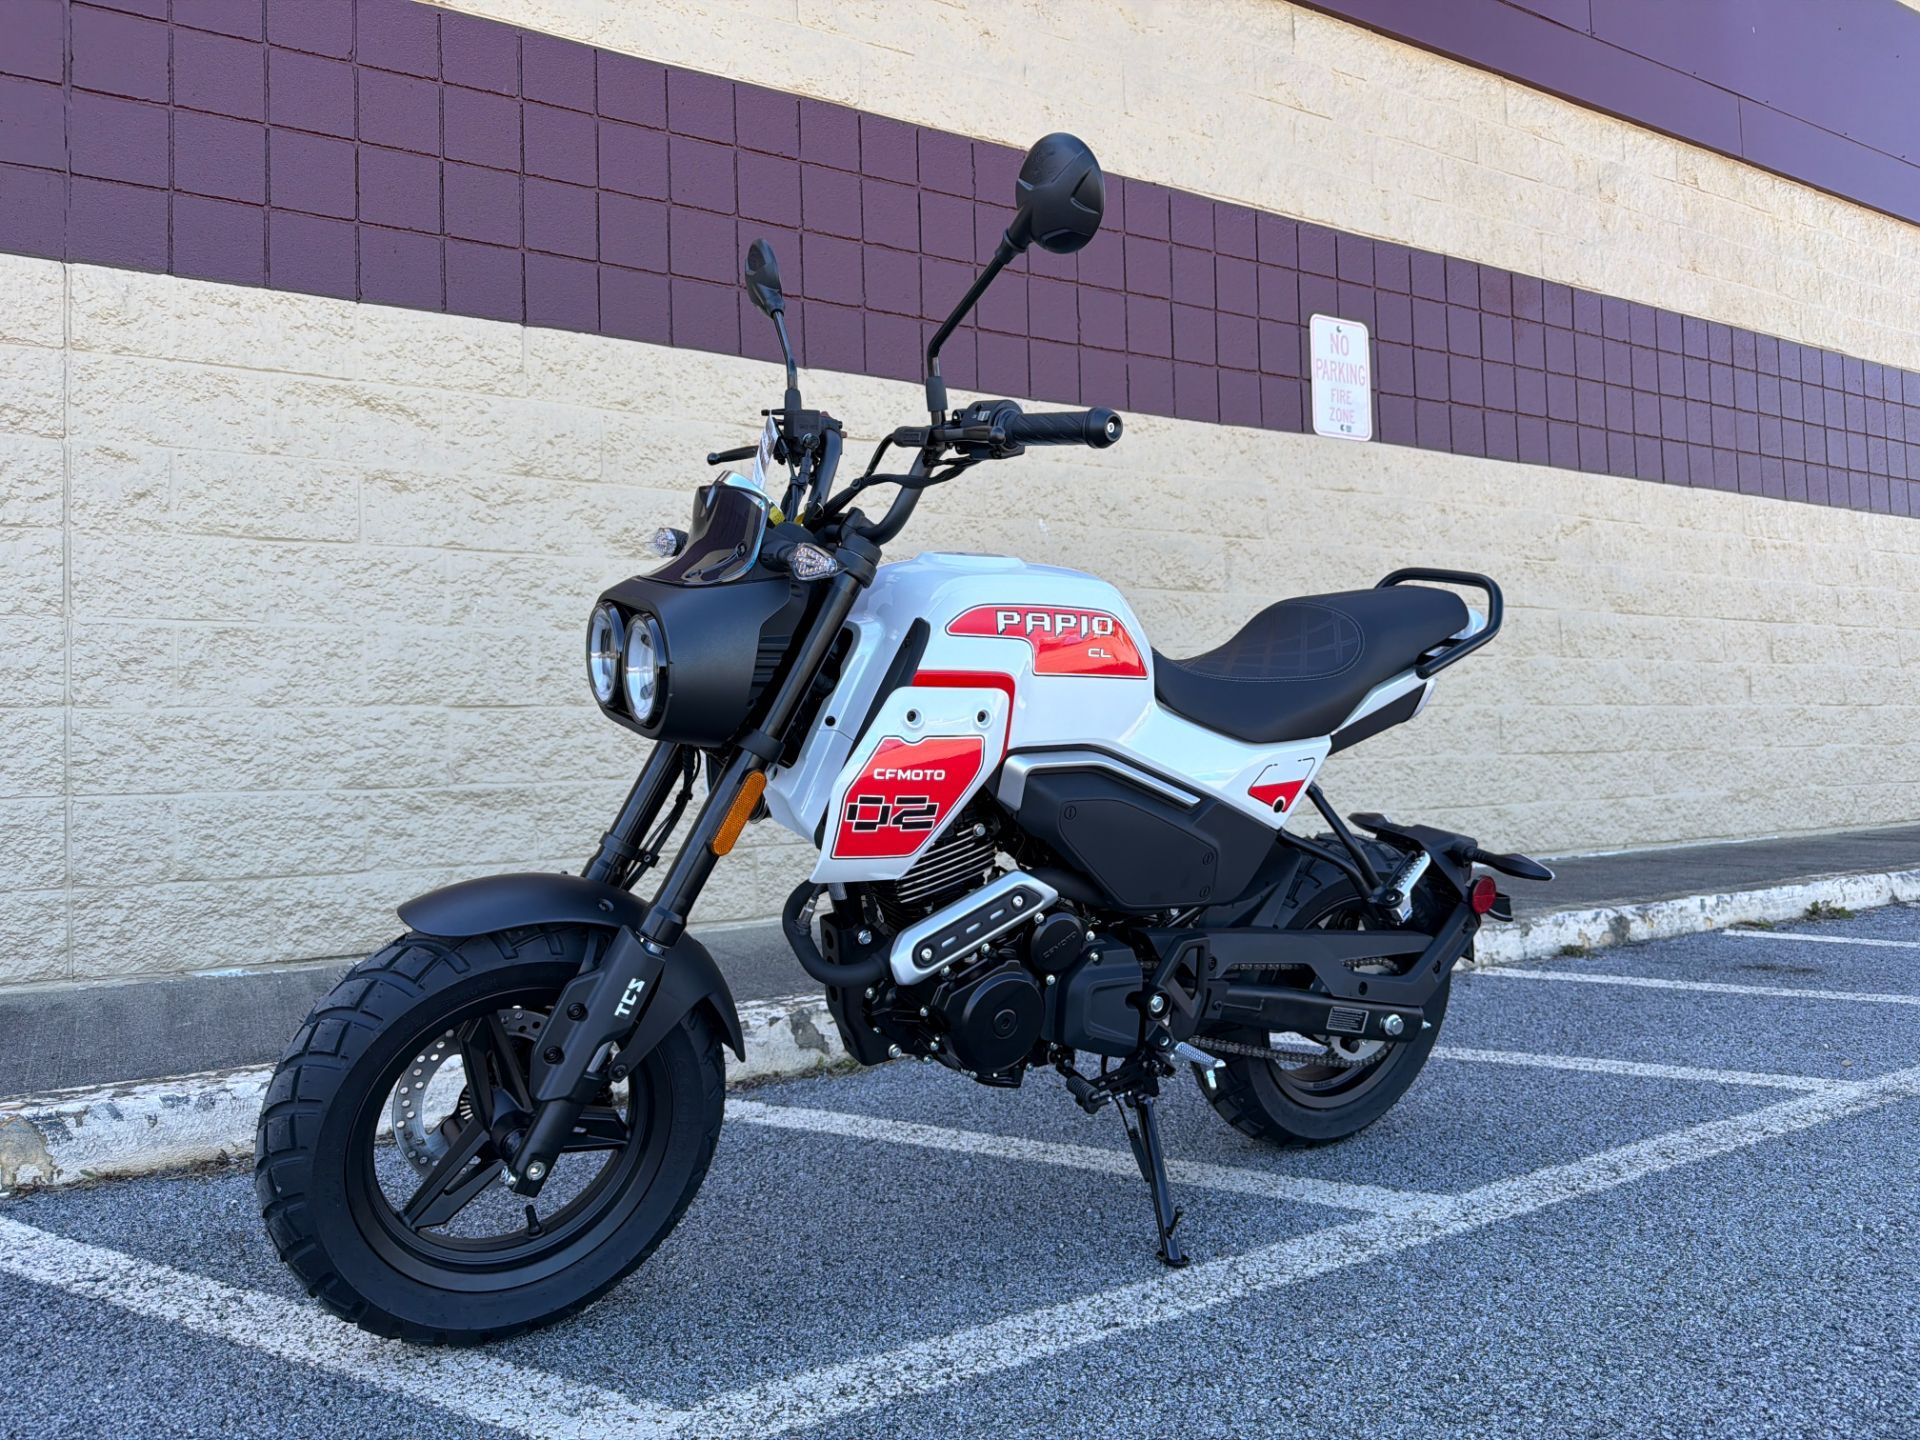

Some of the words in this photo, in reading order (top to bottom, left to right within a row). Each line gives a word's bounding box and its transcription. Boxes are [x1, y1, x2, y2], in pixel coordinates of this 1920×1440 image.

[1330, 333, 1349, 356] NO
[1316, 358, 1366, 386] PARKING
[1330, 388, 1352, 405] FIRE
[1329, 407, 1355, 424] ZONE
[996, 610, 1114, 639] PAPIO
[1087, 648, 1112, 658] CL
[873, 768, 945, 781] CFMOTO
[845, 794, 940, 832] 02
[614, 978, 645, 1016] TCS
